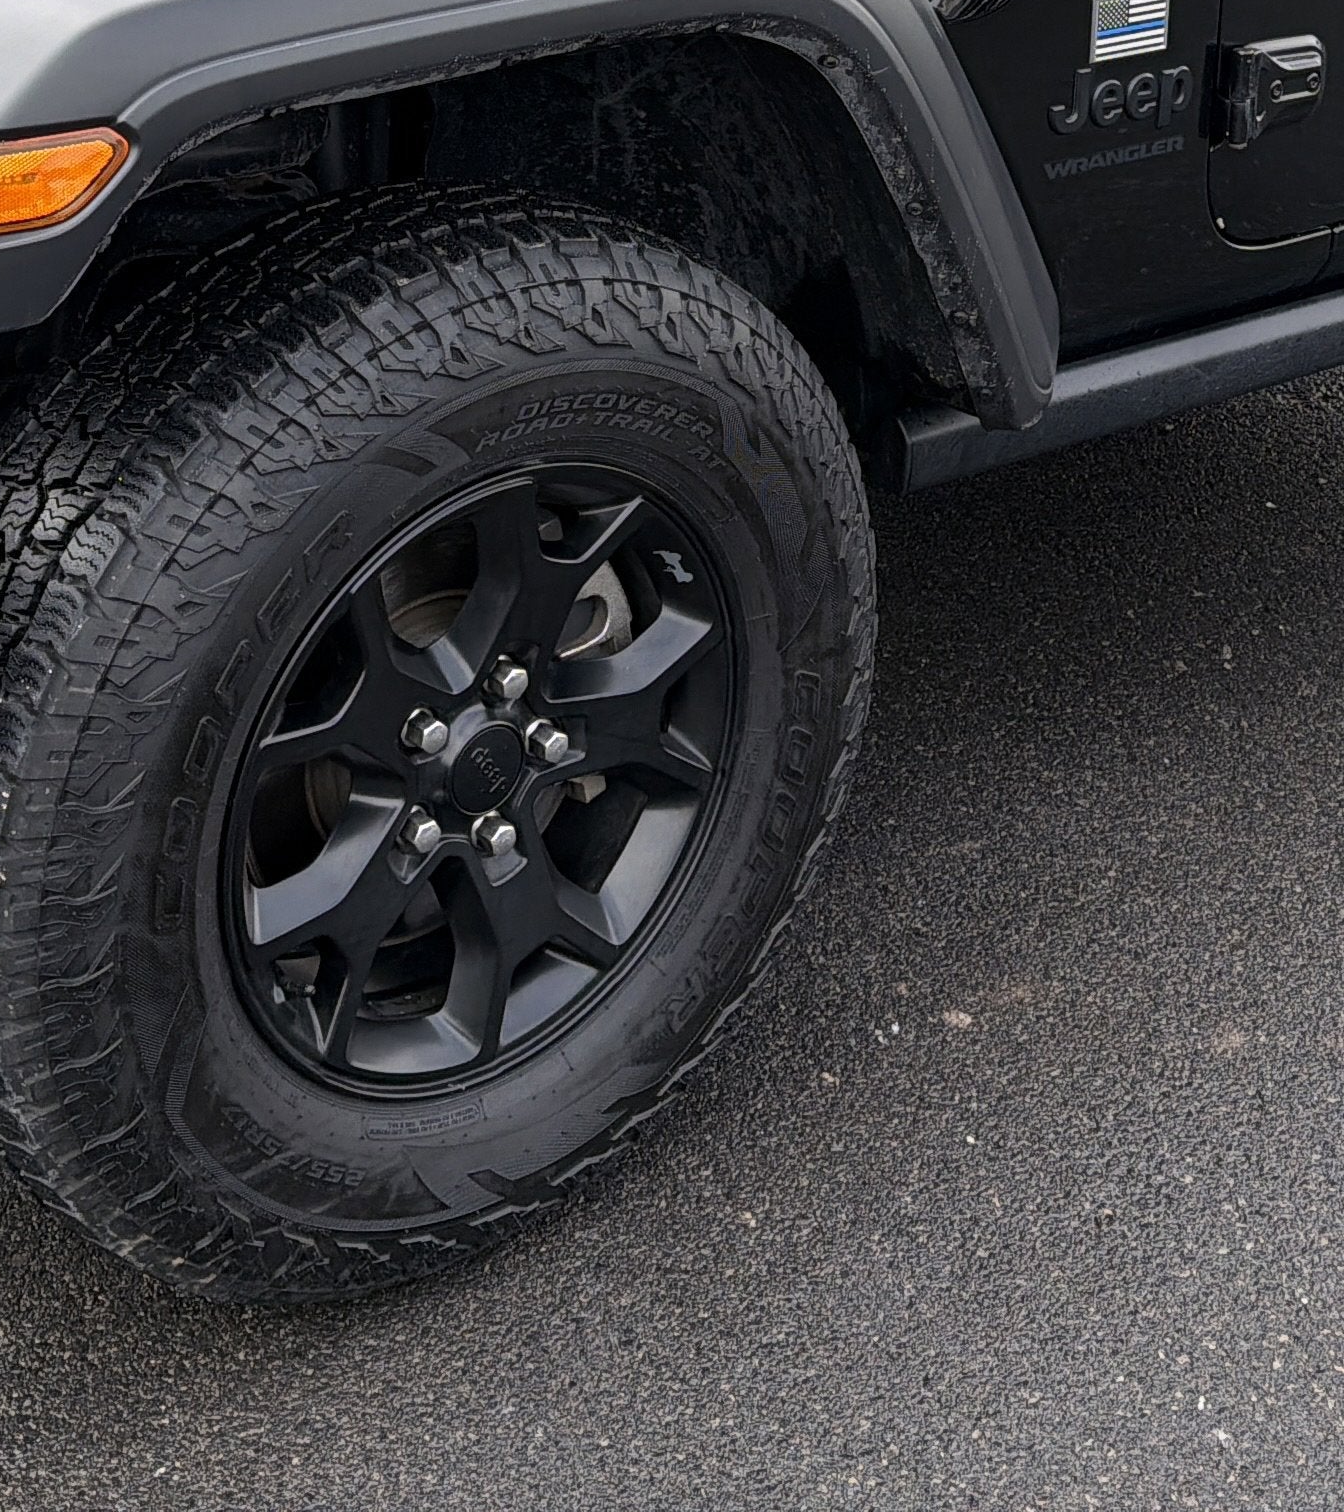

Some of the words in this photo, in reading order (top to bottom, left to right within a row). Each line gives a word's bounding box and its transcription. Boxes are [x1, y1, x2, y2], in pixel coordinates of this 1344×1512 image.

[1048, 65, 1193, 136] Jeep
[1042, 135, 1185, 181] WRANGLER
[516, 392, 715, 440] DISCOVERER
